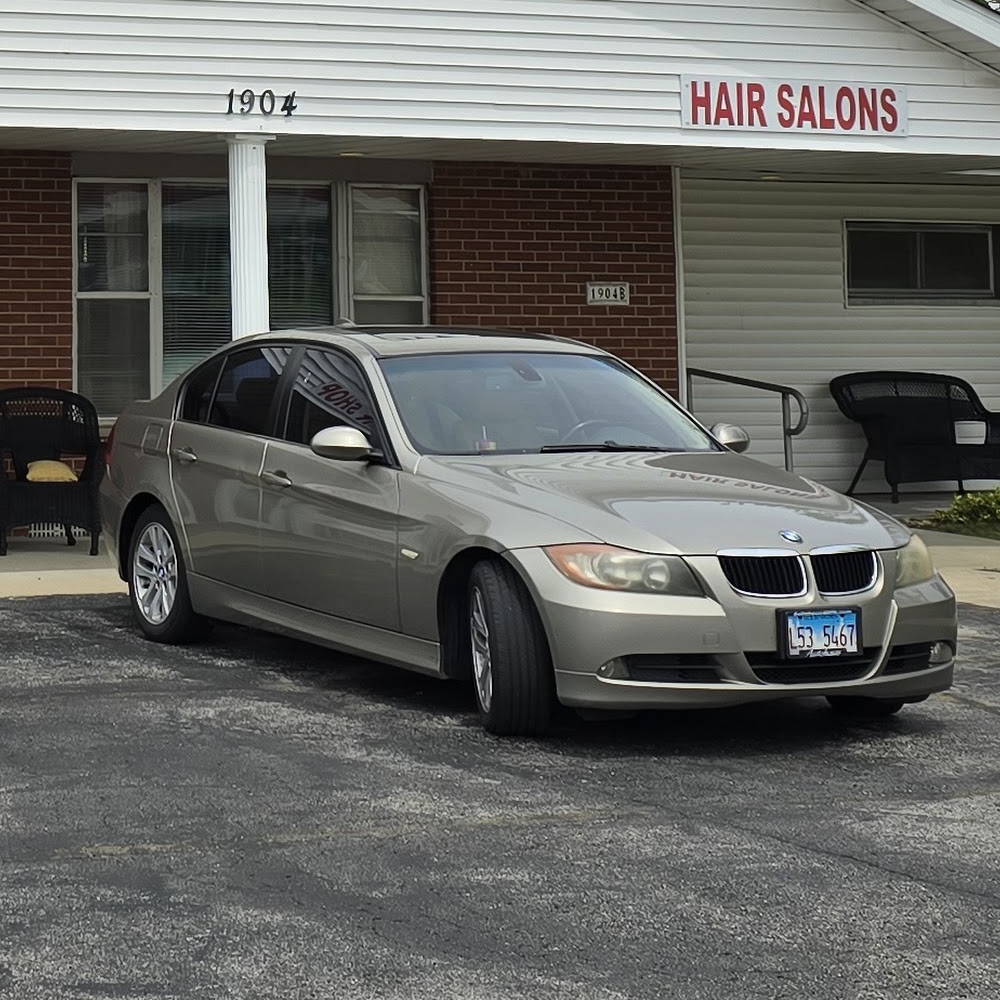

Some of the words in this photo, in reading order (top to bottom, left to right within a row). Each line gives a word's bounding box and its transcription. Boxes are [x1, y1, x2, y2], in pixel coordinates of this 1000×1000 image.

[226, 88, 298, 117] 1904
[690, 80, 768, 127] HAIR
[777, 83, 898, 132] SALONS
[591, 286, 626, 301] 1904B
[823, 624, 855, 648] 5467
